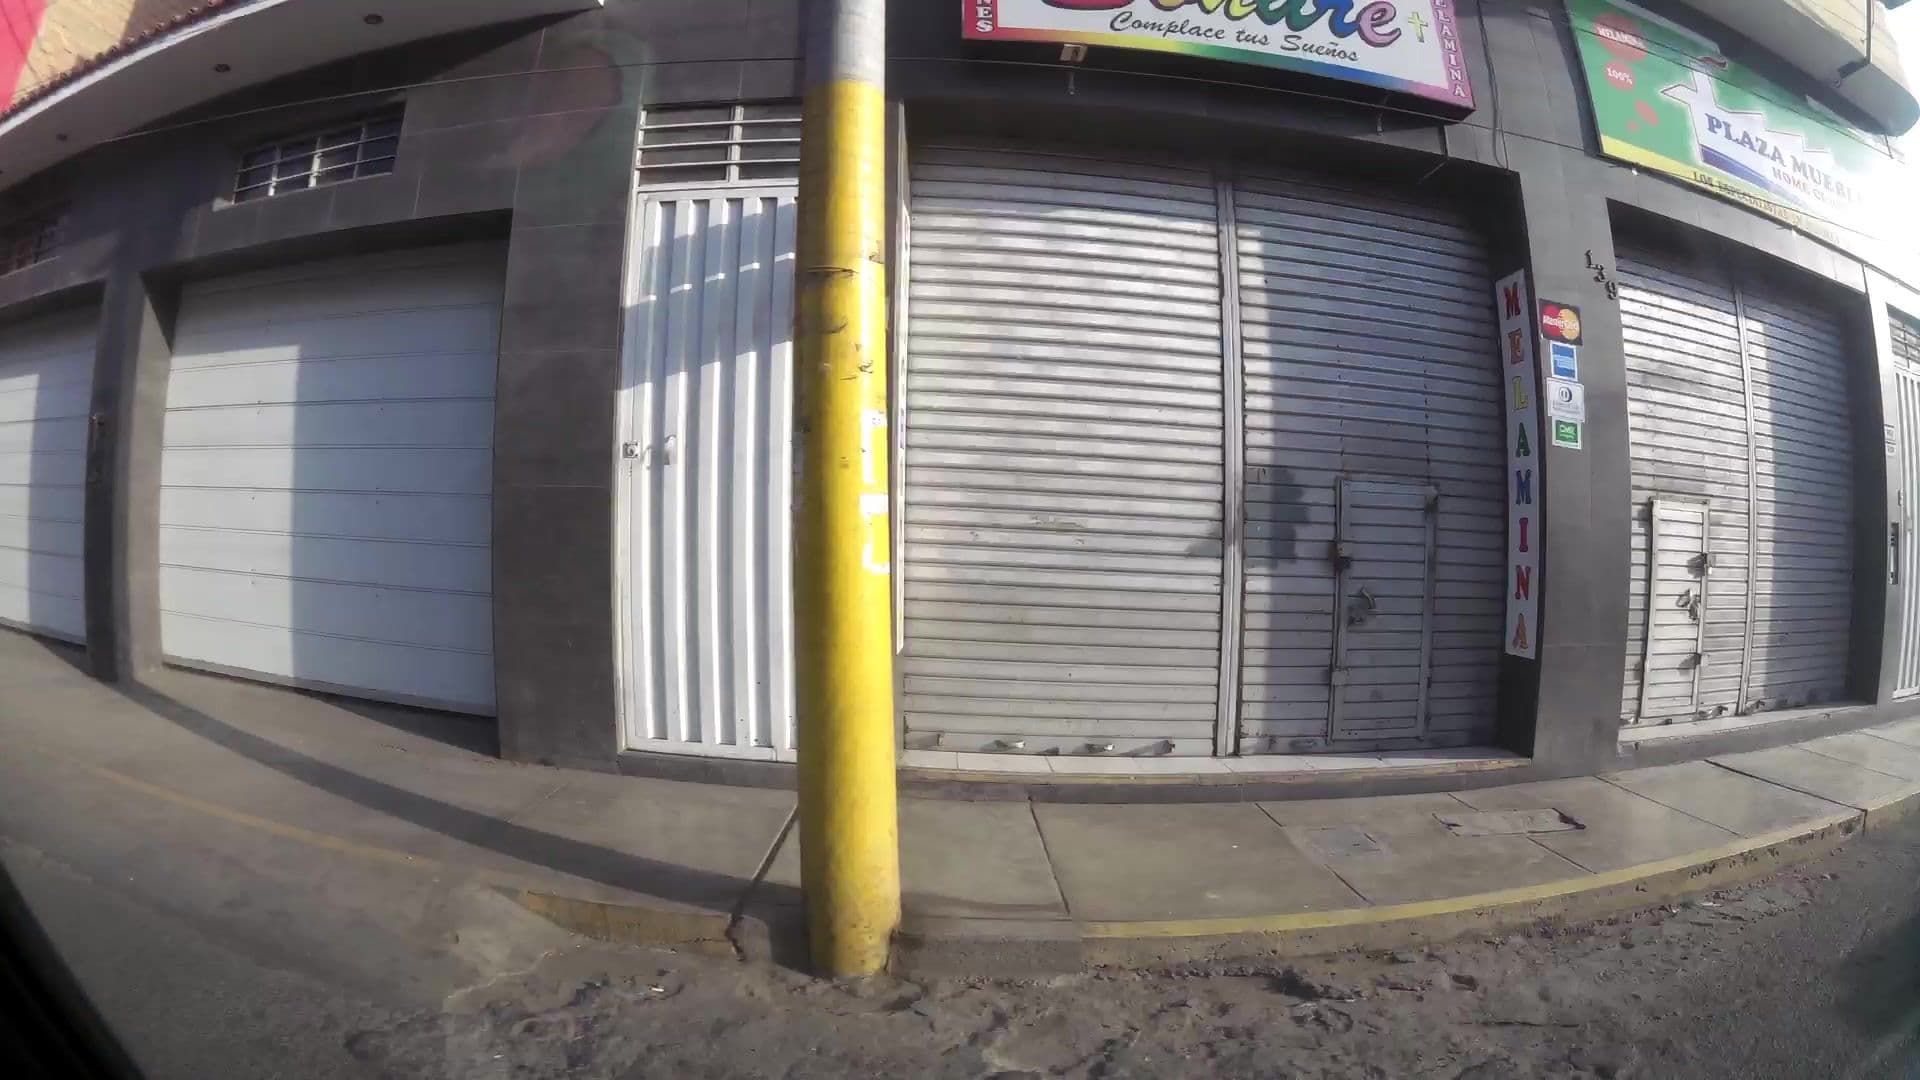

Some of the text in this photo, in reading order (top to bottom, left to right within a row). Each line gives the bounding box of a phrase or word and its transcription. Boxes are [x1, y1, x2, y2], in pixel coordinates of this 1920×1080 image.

[1109, 10, 1361, 63] Complace tus Sueños
[1606, 67, 1634, 86] 100%
[1704, 112, 1787, 168] PLAZA
[1503, 282, 1533, 651] MELAMINA
